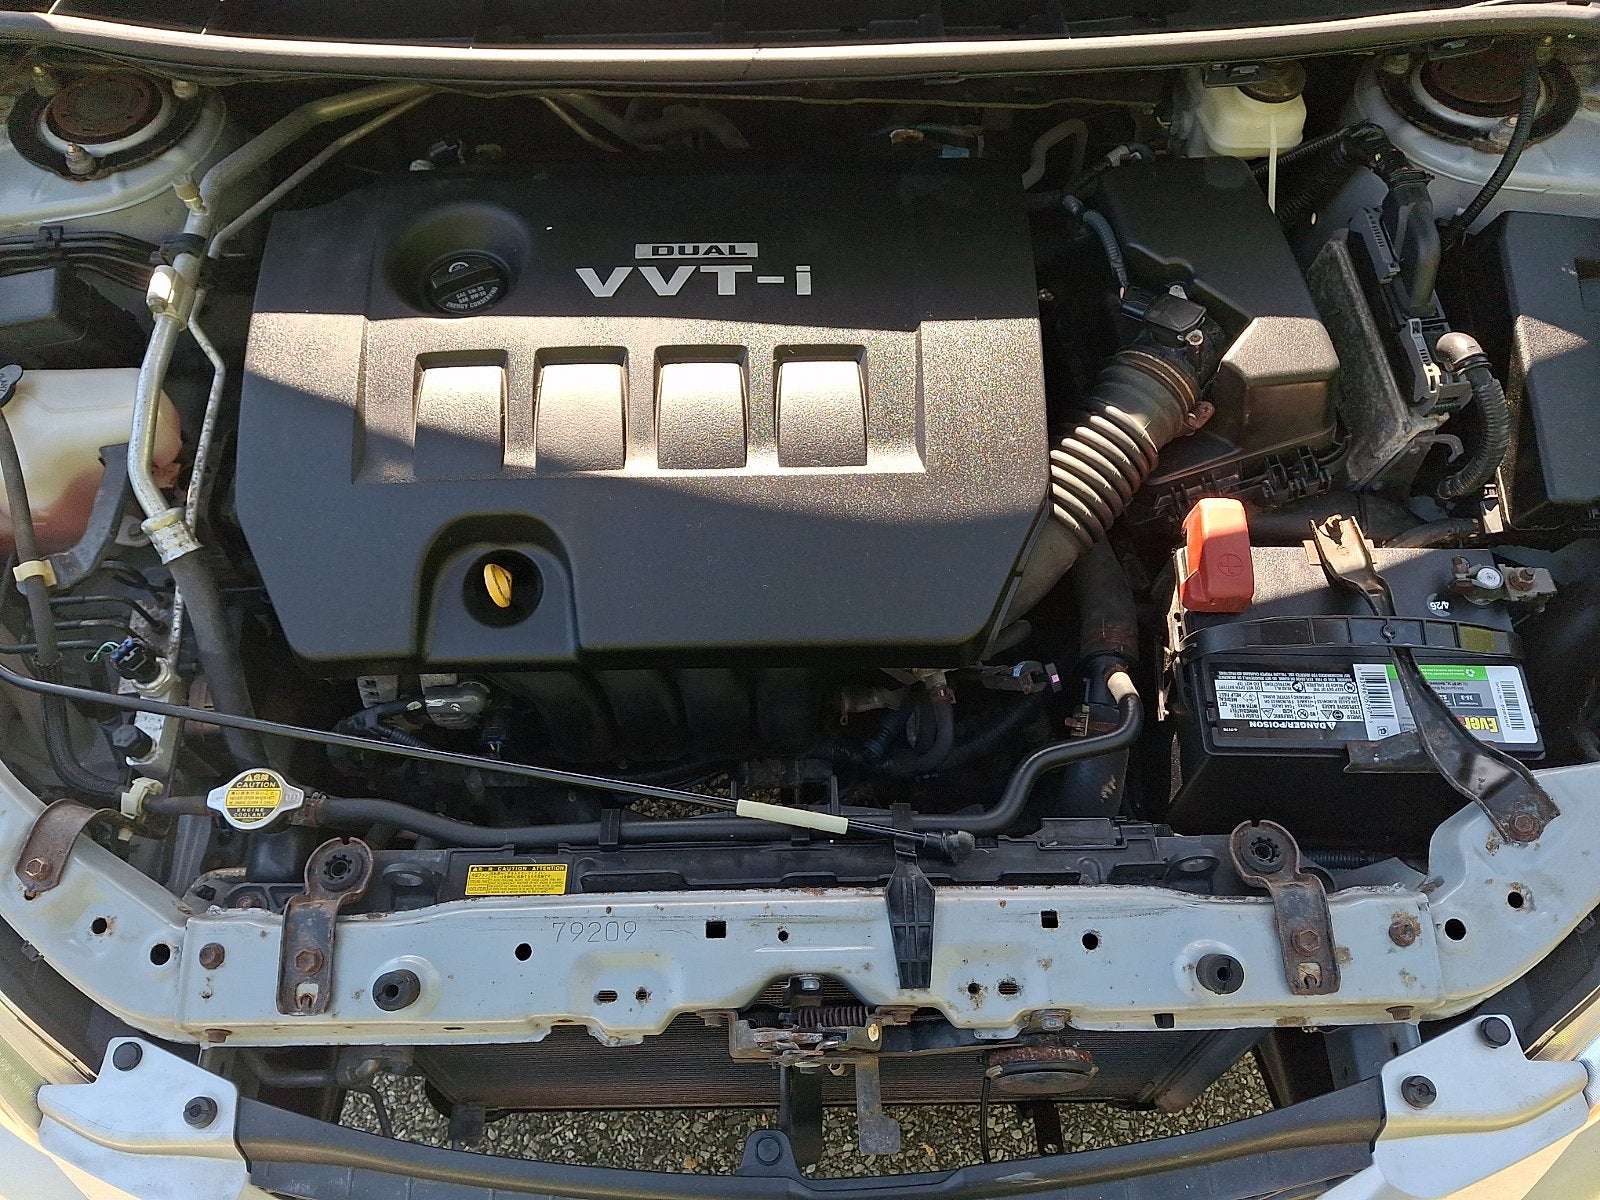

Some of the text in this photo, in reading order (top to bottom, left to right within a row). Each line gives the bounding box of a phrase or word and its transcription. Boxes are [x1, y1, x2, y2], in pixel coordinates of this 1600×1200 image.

[651, 245, 748, 256] DUAL
[574, 264, 812, 298] VVT-i
[1249, 721, 1327, 729] DANGER/POISON
[552, 921, 636, 942] 79209
